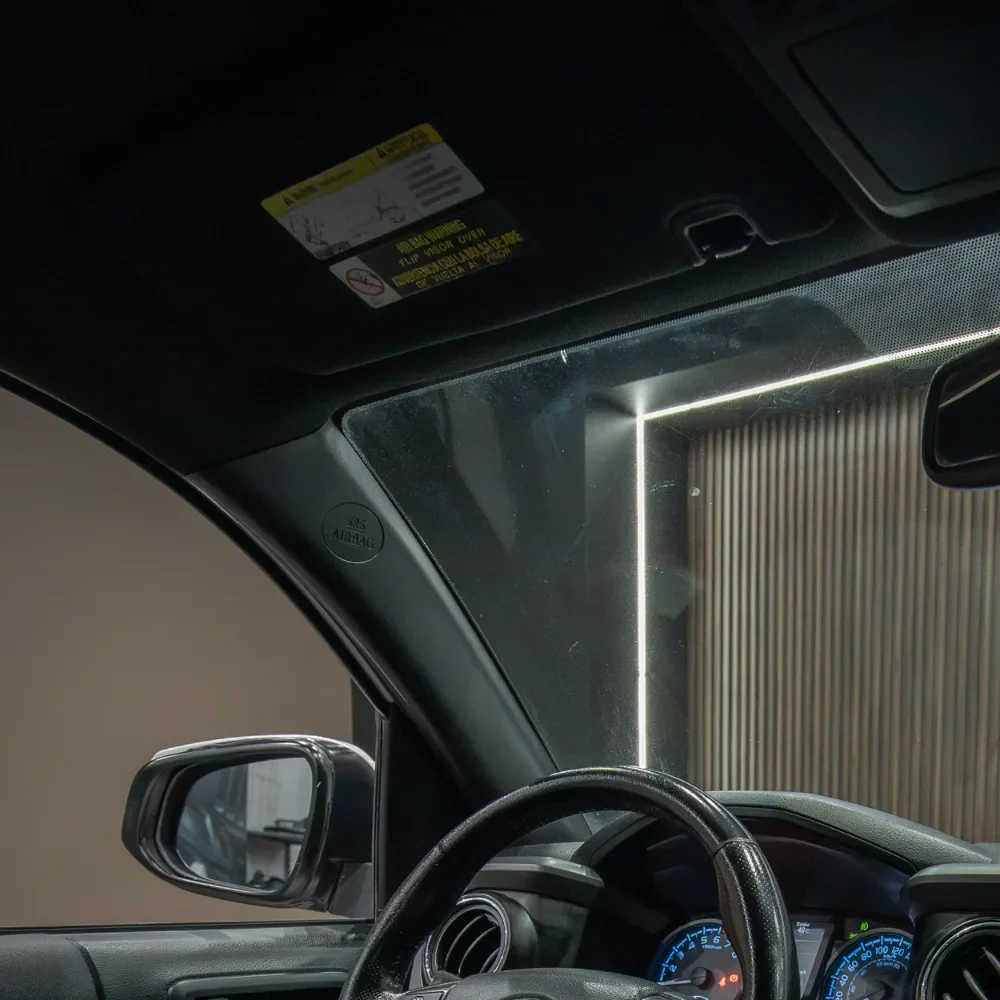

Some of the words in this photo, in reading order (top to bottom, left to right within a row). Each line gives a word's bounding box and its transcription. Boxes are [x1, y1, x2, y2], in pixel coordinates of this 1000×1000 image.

[700, 936, 708, 944] 5
[713, 936, 720, 944] 6
[875, 945, 889, 955] 100
[891, 945, 905, 957] 120
